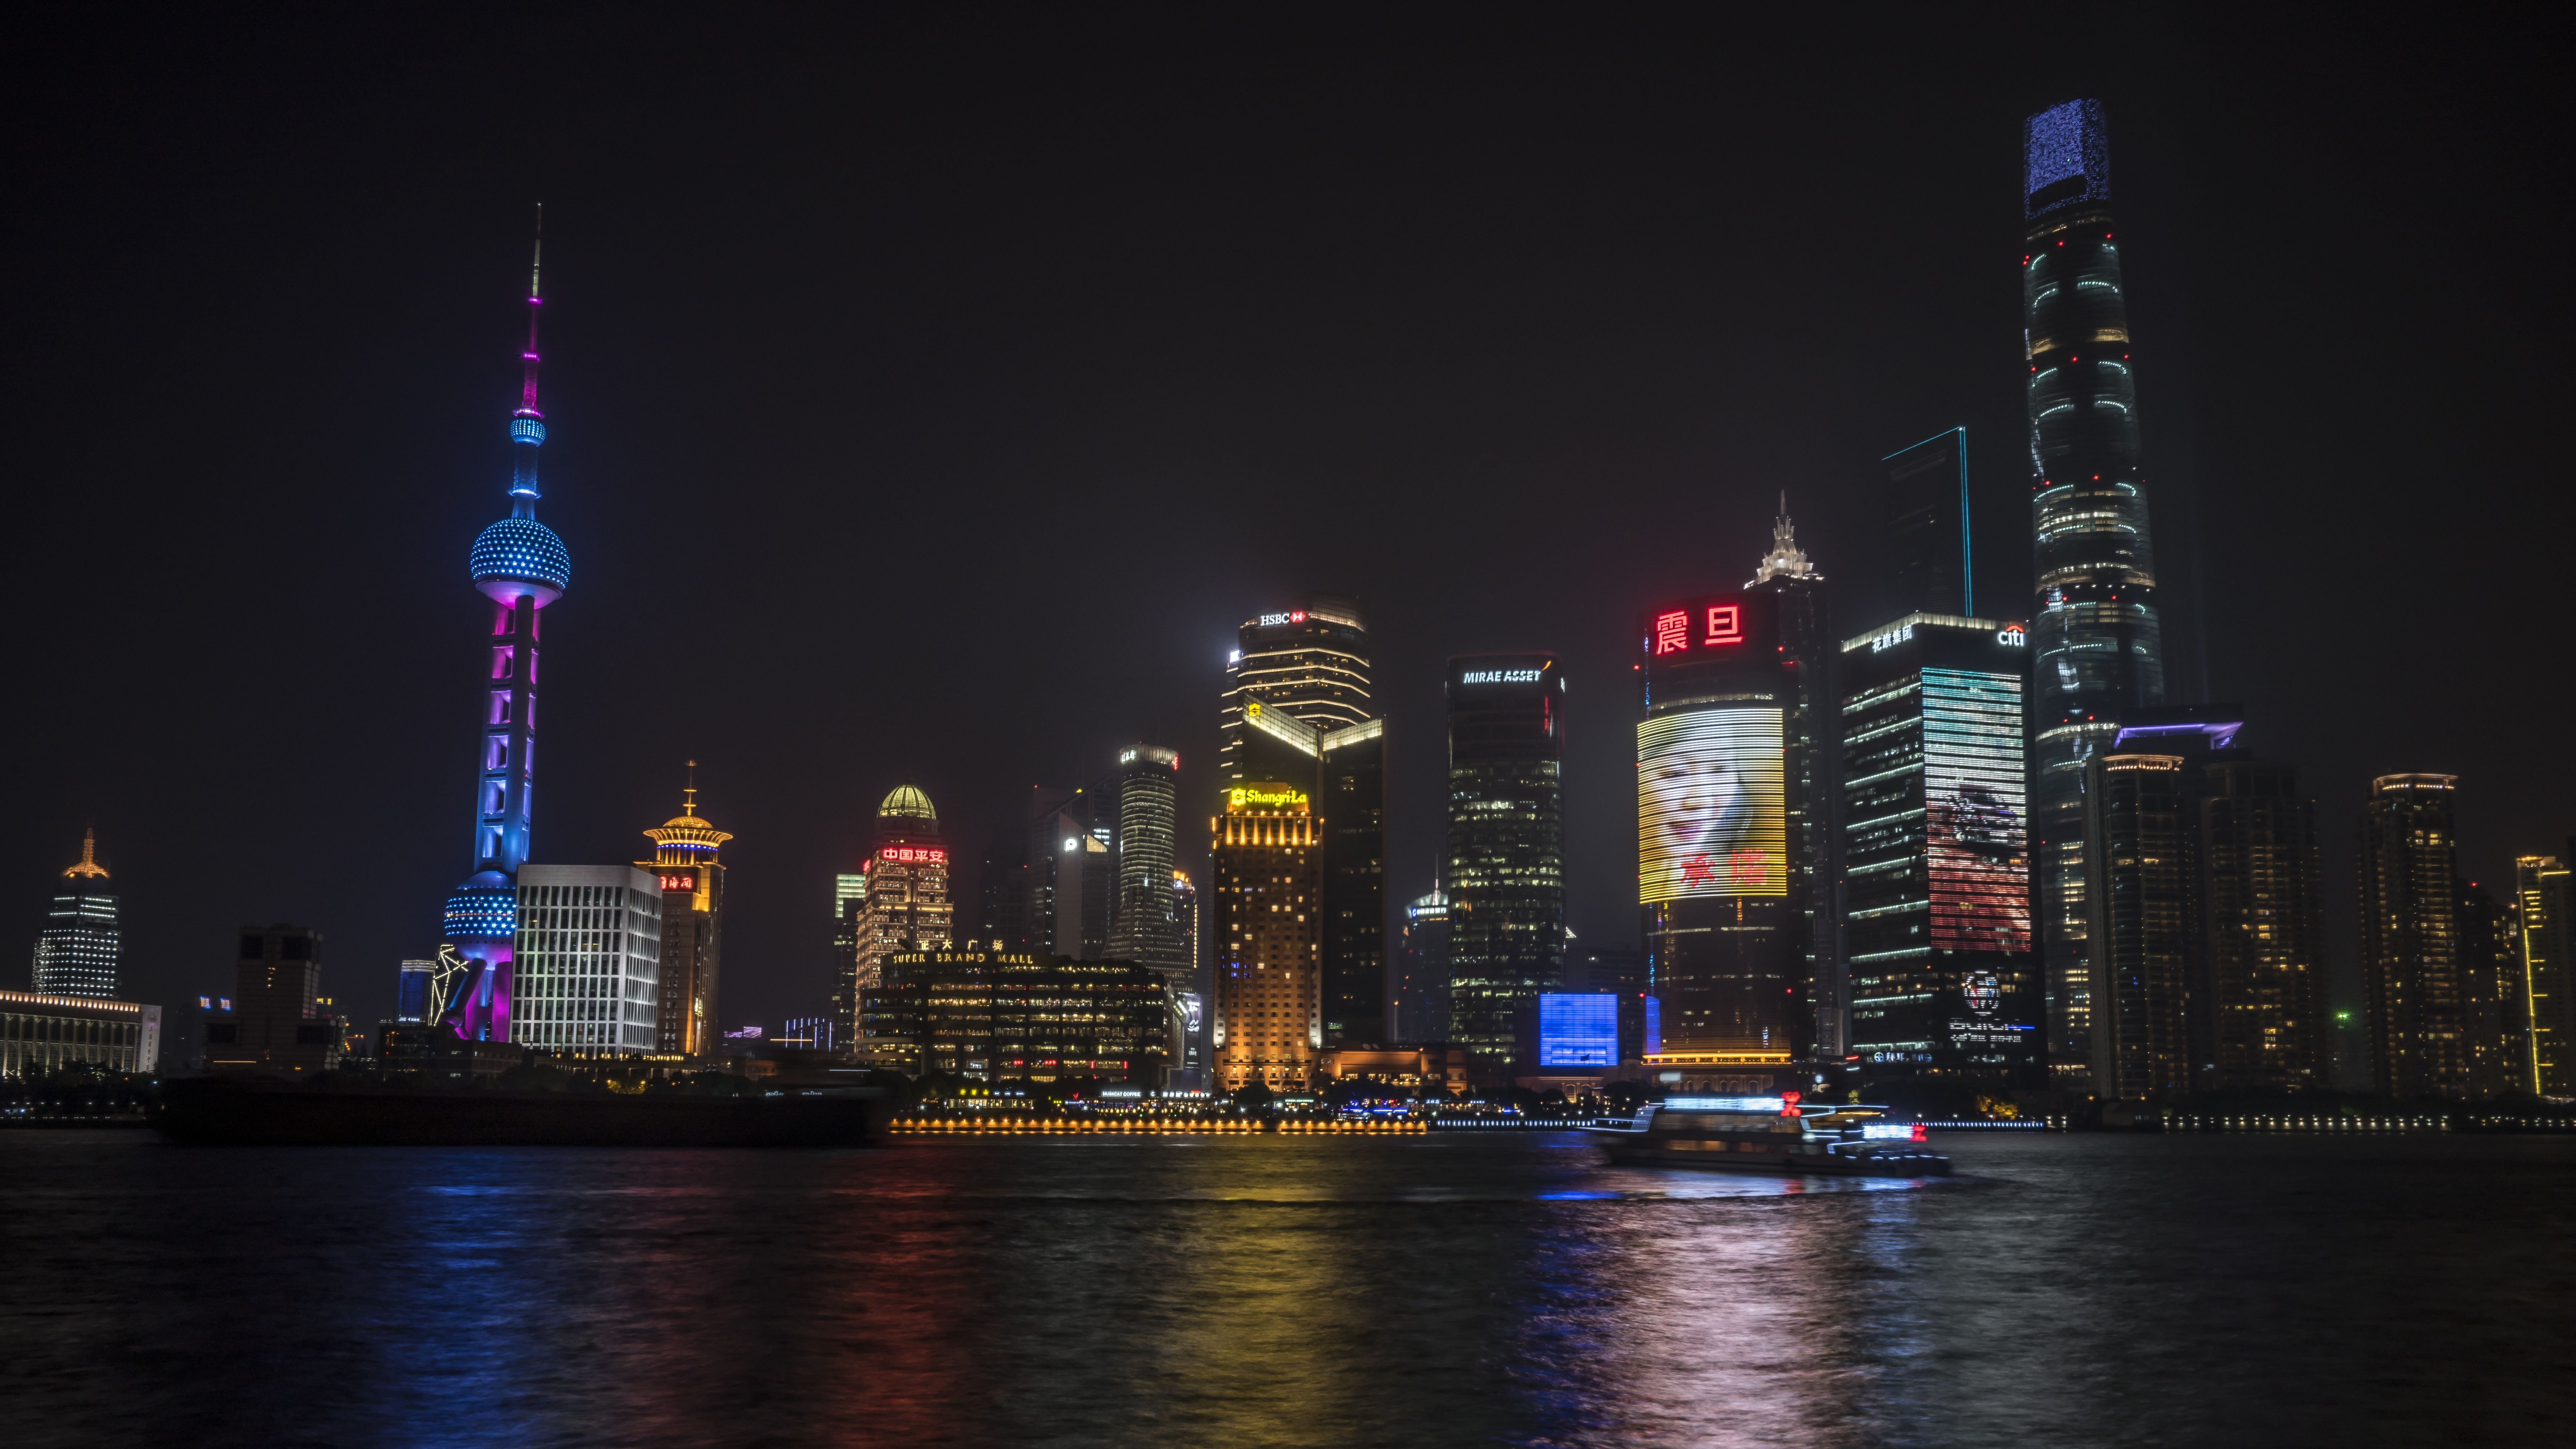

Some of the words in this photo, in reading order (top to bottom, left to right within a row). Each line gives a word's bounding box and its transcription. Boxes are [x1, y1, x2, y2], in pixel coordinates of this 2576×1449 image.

[1260, 613, 1290, 626] HSBC
[1656, 605, 1743, 655] 震旦
[1997, 625, 2025, 647] citi
[1872, 624, 1913, 654] 花旗集团
[1463, 670, 1502, 683] MIRAE
[1503, 670, 1541, 682] ASSET
[1246, 789, 1307, 807] Shangri-La
[884, 847, 944, 862] 中国平安
[919, 939, 1004, 951] 正大广场
[893, 953, 926, 964] SUPER
[937, 953, 986, 963] BRAND
[998, 954, 1033, 964] MALL
[1886, 1052, 1905, 1061] 拜耳
